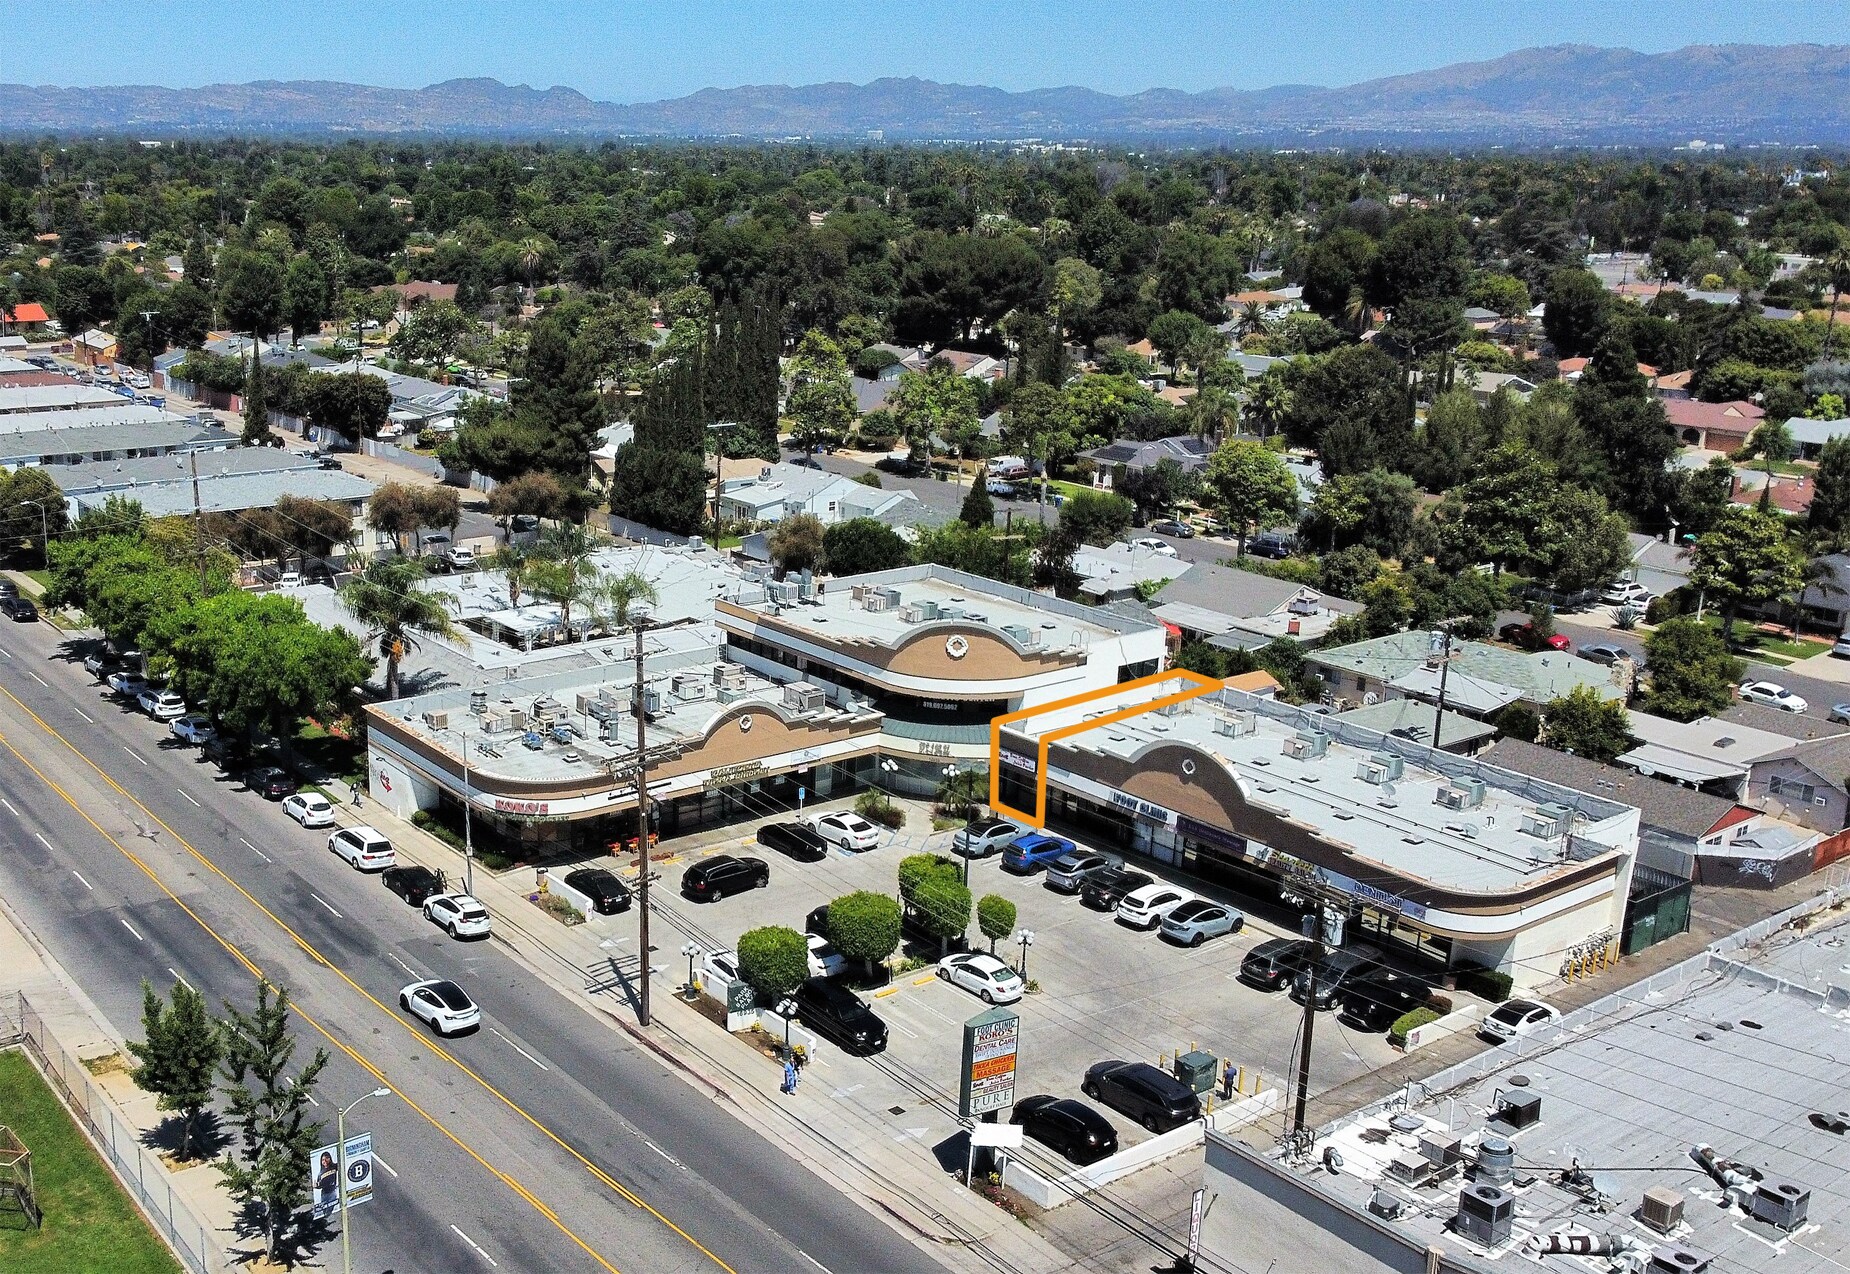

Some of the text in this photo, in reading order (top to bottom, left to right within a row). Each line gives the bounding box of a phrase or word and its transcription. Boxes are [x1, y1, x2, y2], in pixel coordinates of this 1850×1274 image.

[495, 800, 549, 815] KOKO'S
[1139, 803, 1168, 822] CLINIC
[734, 986, 749, 1002] PARK
[977, 1019, 1015, 1036] FOOT CLINIC
[979, 1027, 1013, 1041] KOKO'S
[974, 1042, 997, 1053] DENTAL
[991, 1055, 1015, 1067] CHICKEN
[976, 1063, 1011, 1079] MASSAGE
[973, 1090, 1010, 1109] PURE
[354, 1164, 363, 1178] B
